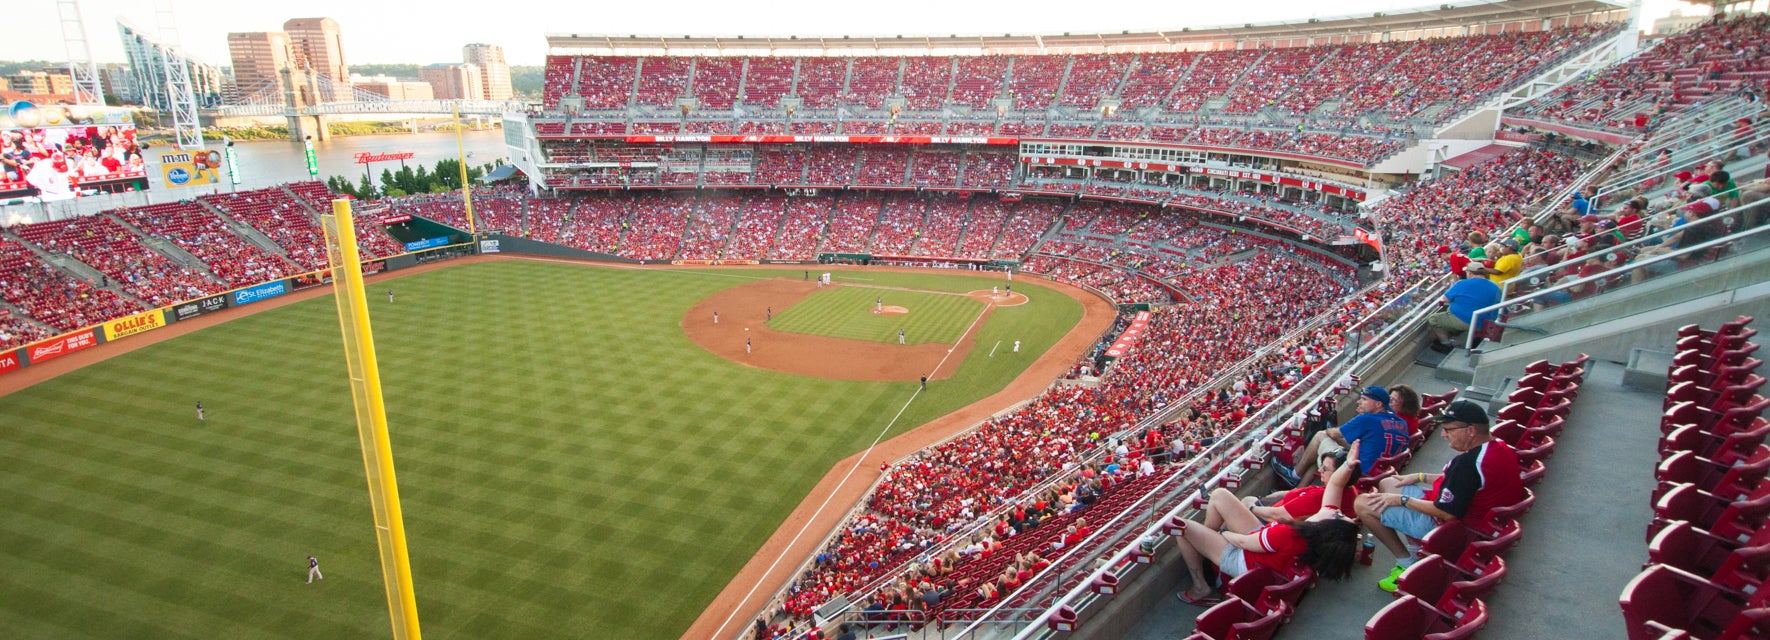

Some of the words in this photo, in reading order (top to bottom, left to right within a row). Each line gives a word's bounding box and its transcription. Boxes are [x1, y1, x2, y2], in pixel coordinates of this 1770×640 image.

[354, 151, 414, 164] Budweiser
[256, 284, 283, 297] Elizabeth
[202, 296, 225, 308] JACK
[113, 329, 138, 339] BARGAIN
[138, 322, 159, 333] OUTLET
[66, 336, 78, 344] THIS
[67, 341, 79, 350] FOR
[0, 356, 15, 369] TA
[1380, 433, 1407, 459] 17
